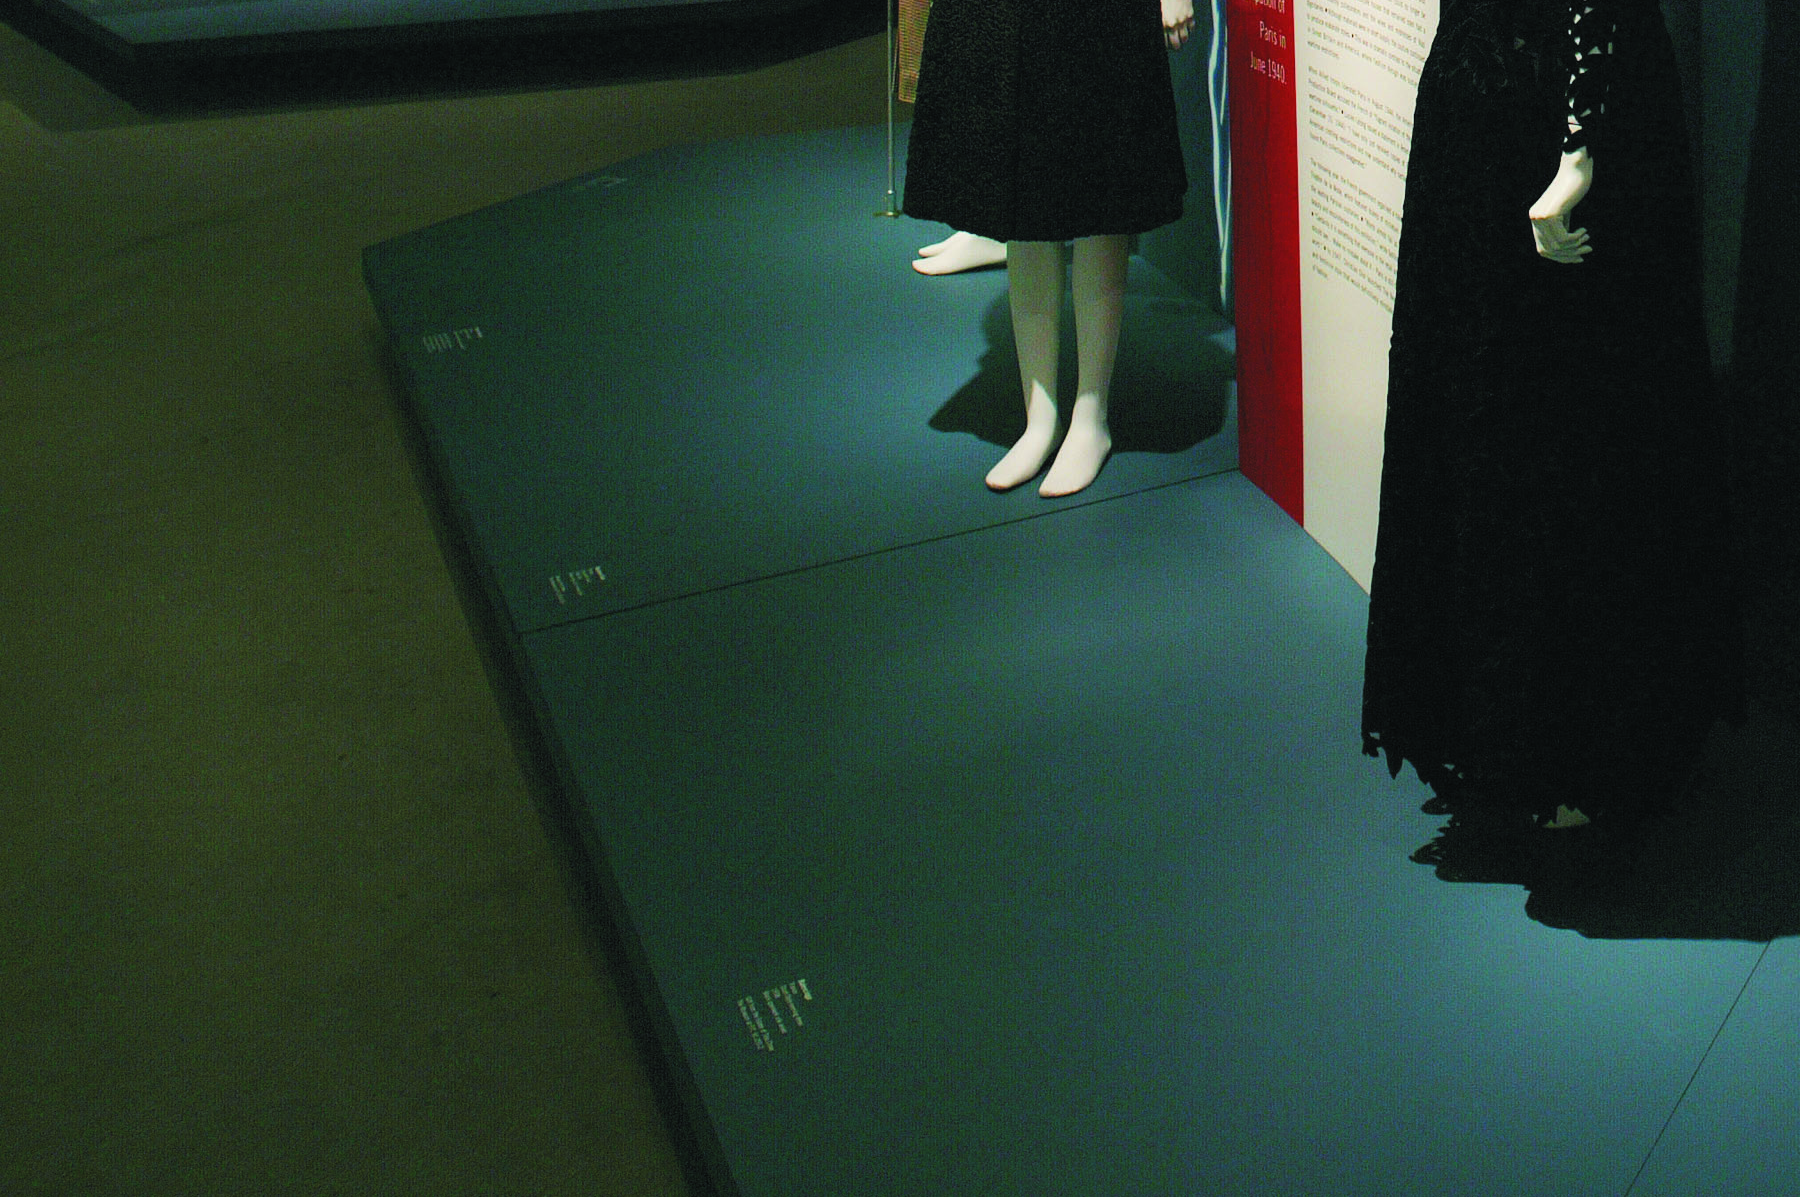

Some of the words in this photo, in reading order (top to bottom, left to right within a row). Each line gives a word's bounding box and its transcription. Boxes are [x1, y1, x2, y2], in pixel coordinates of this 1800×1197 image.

[1259, 20, 1278, 46] Paris
[1279, 29, 1287, 50] in
[1250, 50, 1266, 74] June
[1268, 58, 1288, 85] 1940.
